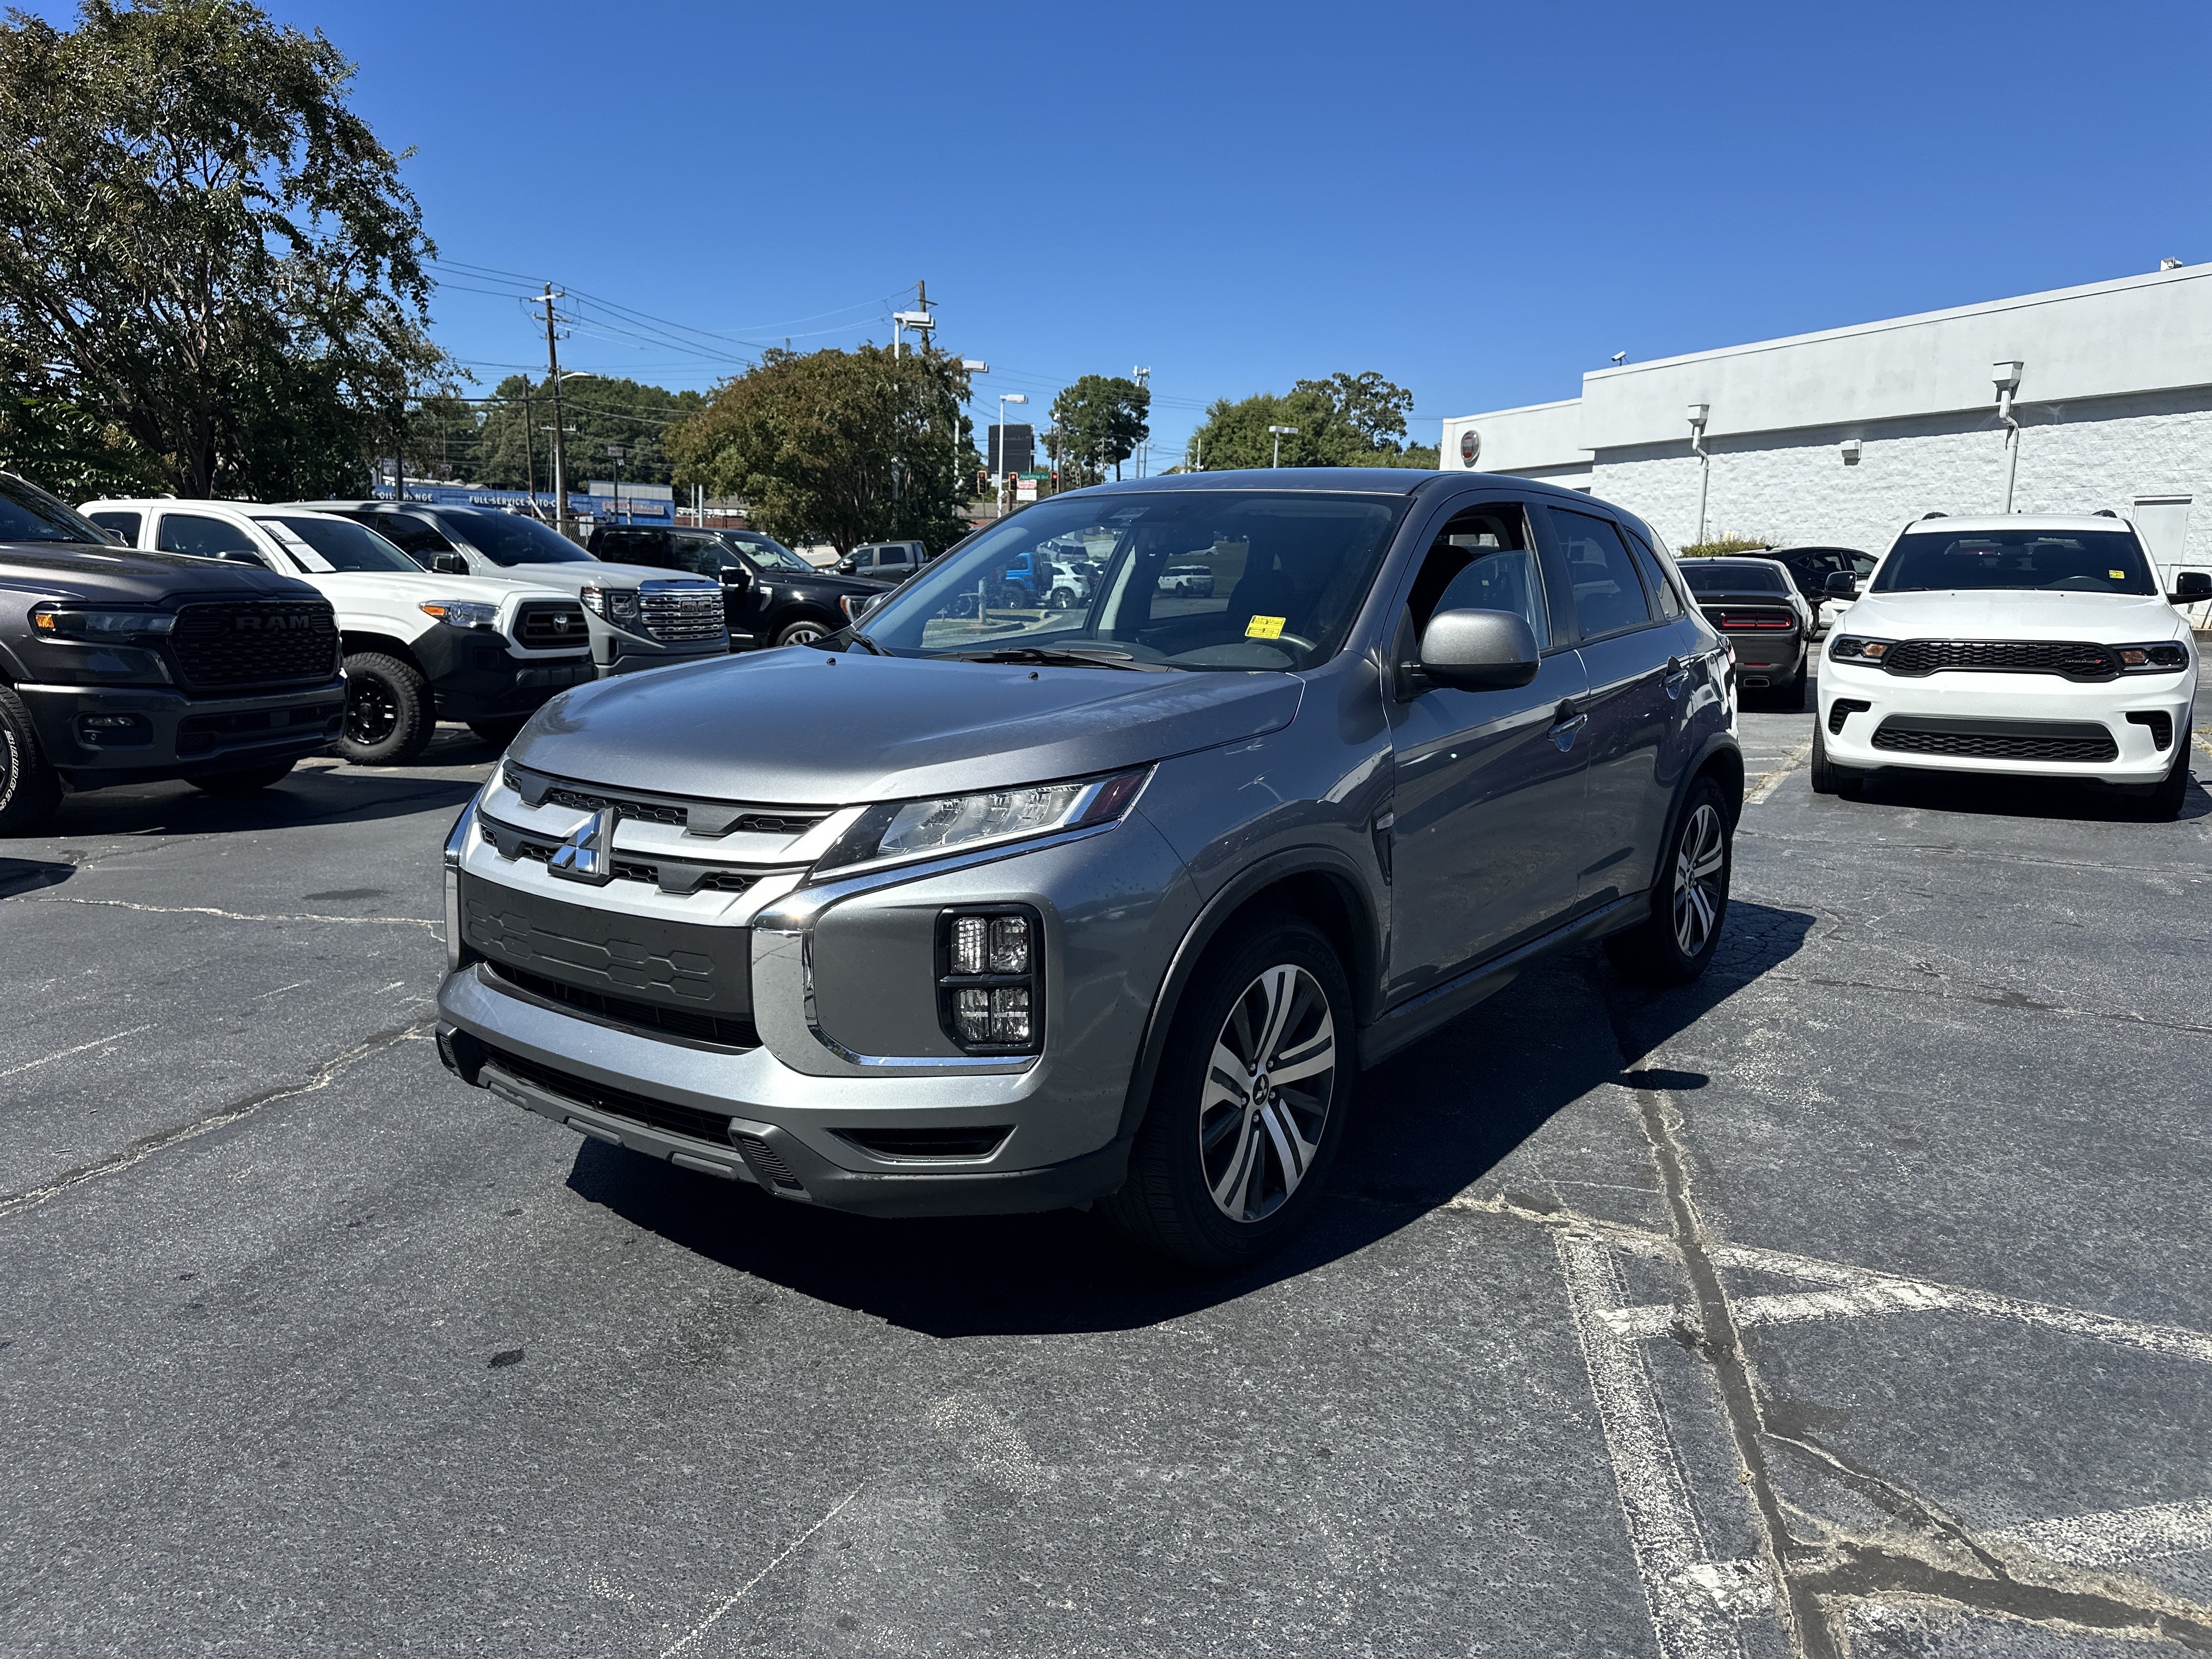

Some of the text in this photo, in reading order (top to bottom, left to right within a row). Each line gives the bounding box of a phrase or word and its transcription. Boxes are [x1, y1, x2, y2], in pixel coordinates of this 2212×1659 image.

[403, 493, 433, 501] HNGE
[550, 499, 572, 508] CE
[682, 601, 712, 612] GMC
[236, 616, 309, 629] RAM
